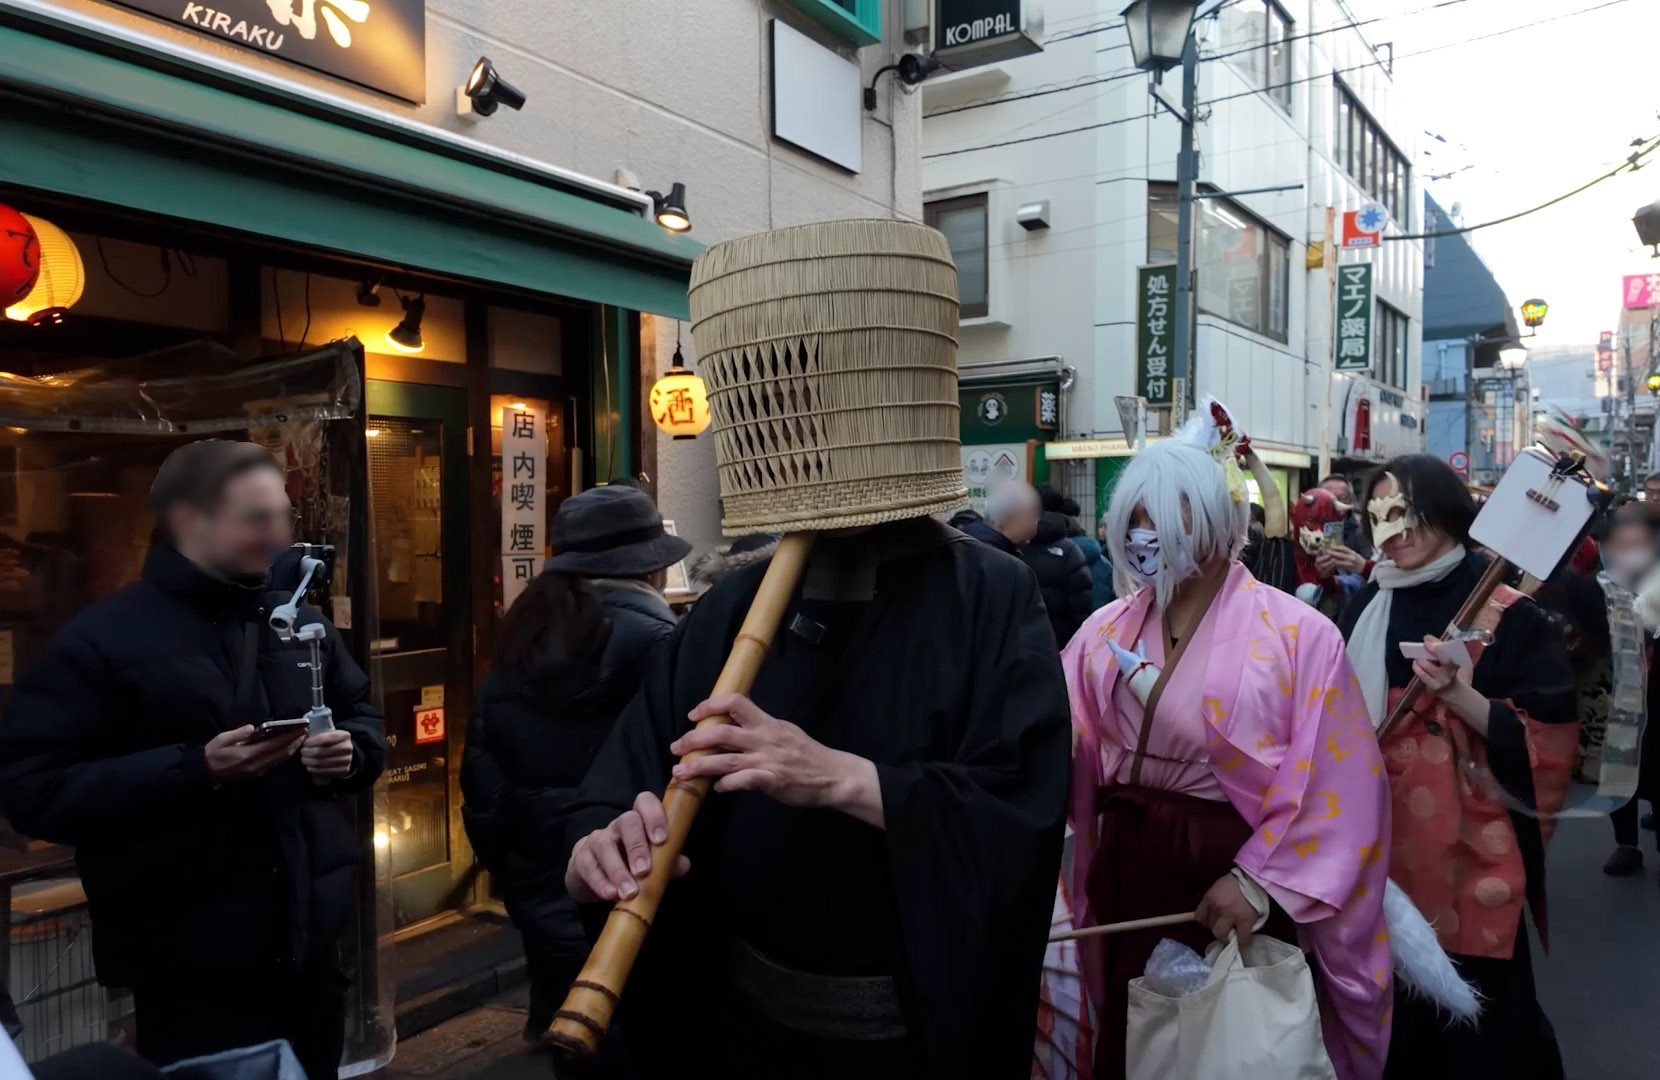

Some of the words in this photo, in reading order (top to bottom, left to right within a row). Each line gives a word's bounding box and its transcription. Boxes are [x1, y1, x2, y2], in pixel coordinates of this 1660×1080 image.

[182, 2, 284, 50] KIRAKU
[946, 12, 1015, 46] KOMPAL
[1340, 267, 1366, 358] マエノ薬局
[1146, 275, 1169, 399] 処方せん受付
[654, 388, 695, 425] 酒
[1071, 444, 1099, 453] MAENO
[510, 411, 535, 580] 店内喫煙可
